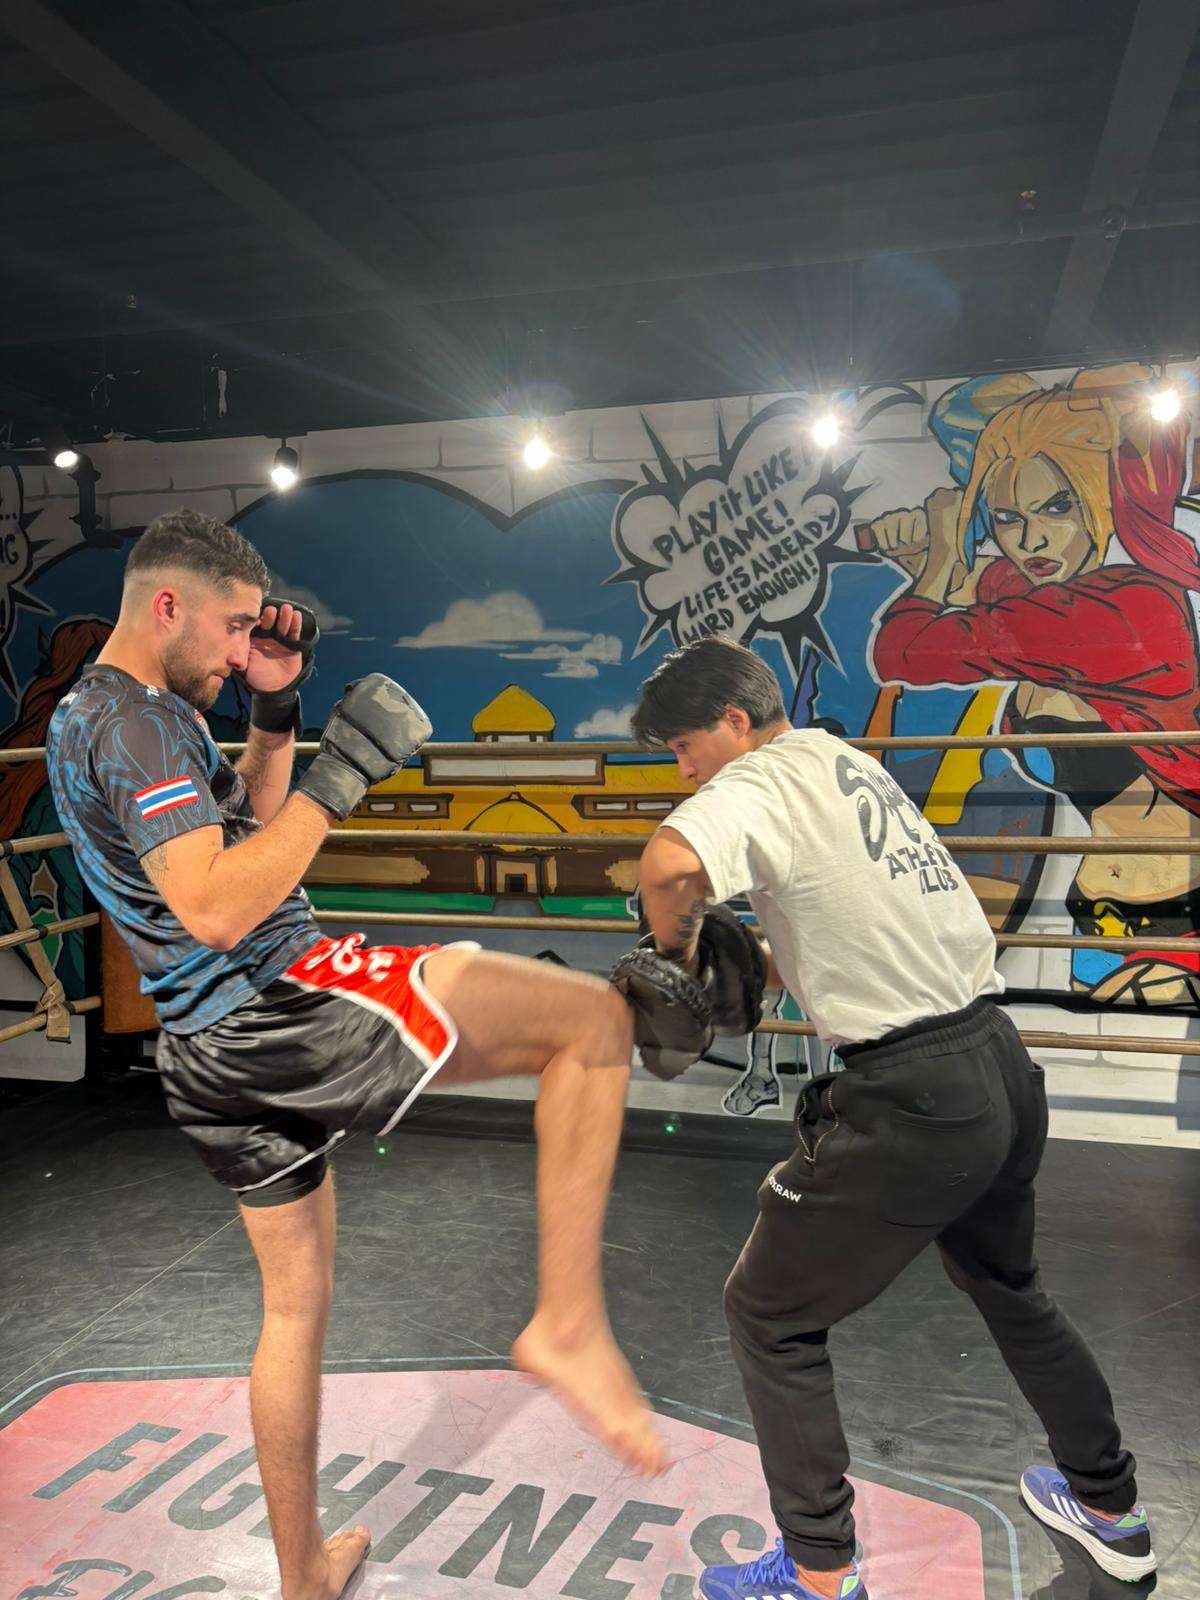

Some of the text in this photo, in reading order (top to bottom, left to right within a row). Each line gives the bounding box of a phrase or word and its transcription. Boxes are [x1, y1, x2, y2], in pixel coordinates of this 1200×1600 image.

[652, 501, 718, 563] PLAY
[703, 498, 795, 576] GAME!
[751, 508, 836, 581] ALREADY
